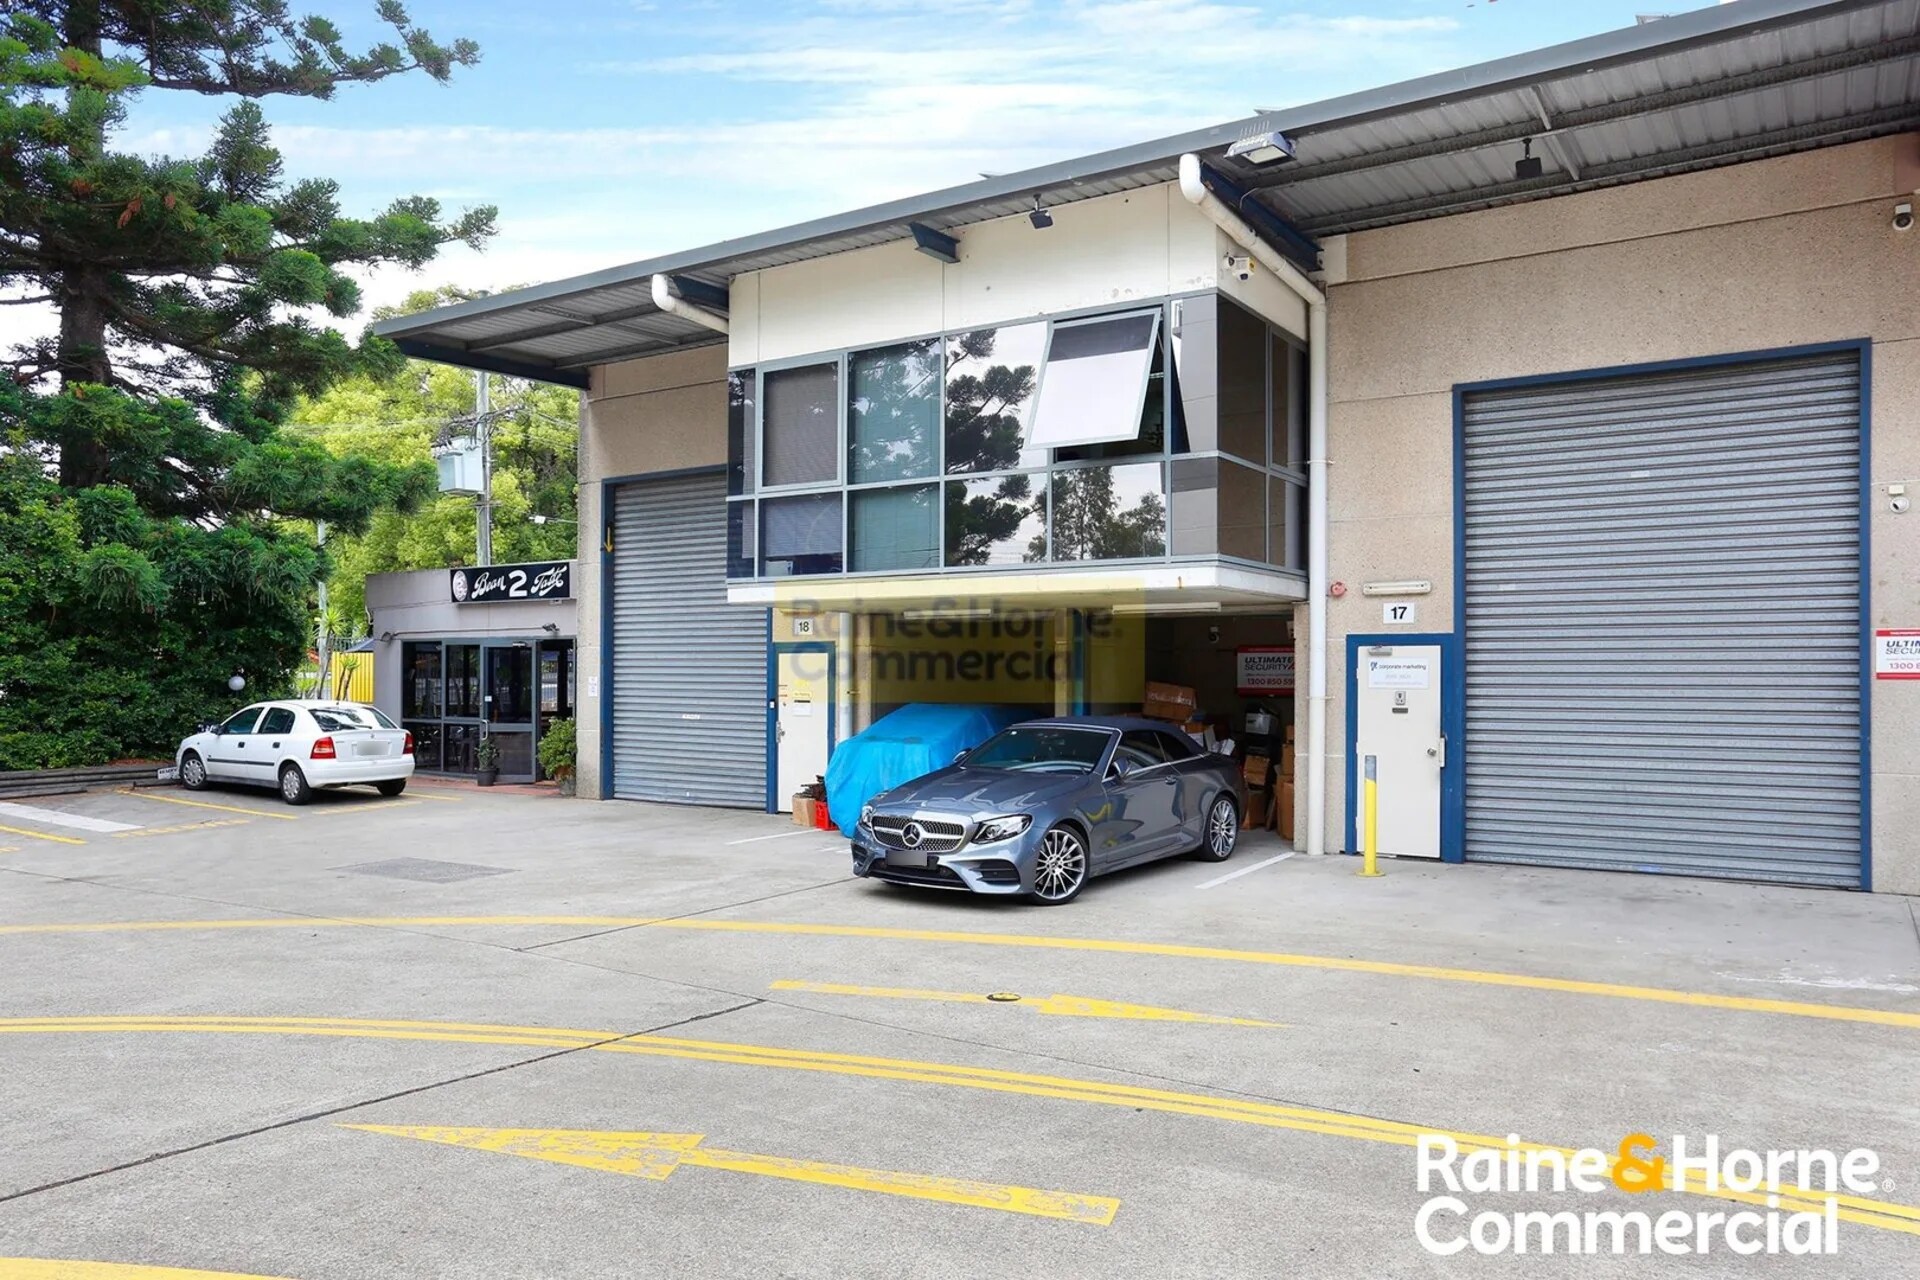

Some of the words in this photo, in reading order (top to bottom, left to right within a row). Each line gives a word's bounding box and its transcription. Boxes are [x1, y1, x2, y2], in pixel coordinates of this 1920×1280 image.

[471, 571, 507, 599] Bean
[508, 569, 528, 597] 2
[1390, 606, 1408, 620] 17
[799, 621, 810, 633] 18
